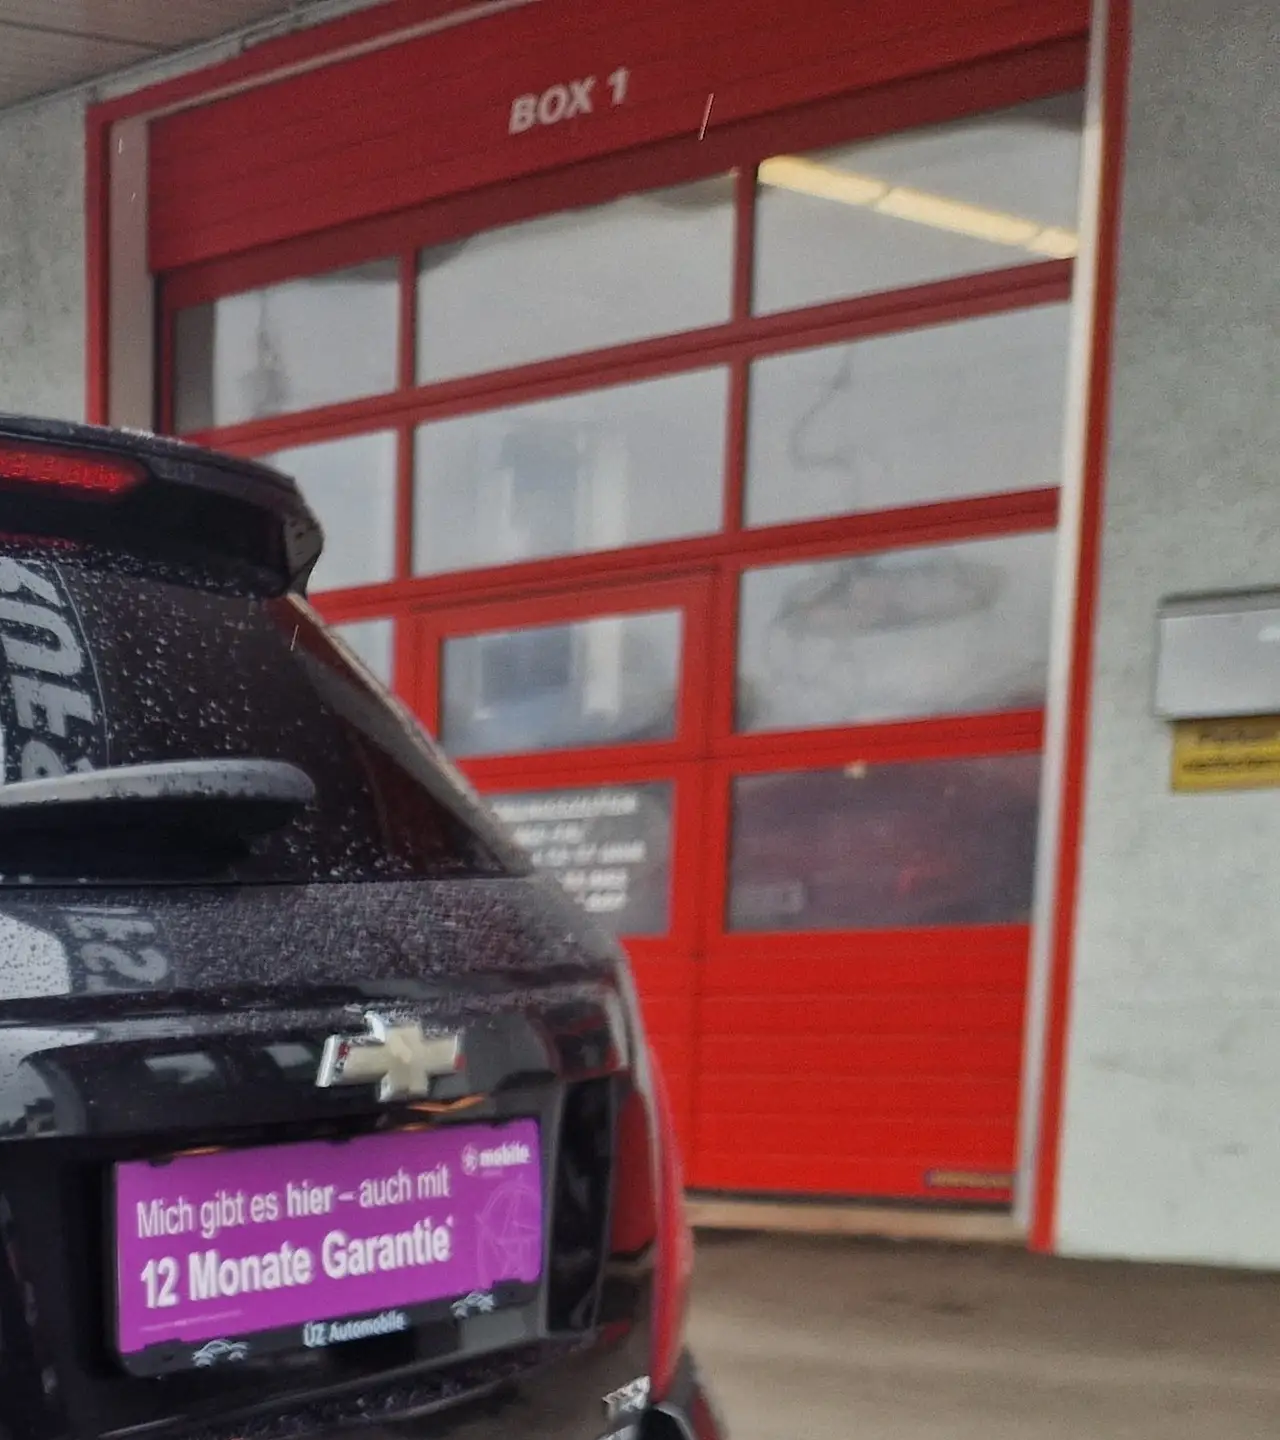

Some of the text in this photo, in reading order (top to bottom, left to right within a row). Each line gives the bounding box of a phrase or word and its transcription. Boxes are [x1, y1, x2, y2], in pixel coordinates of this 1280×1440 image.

[508, 67, 630, 135] BOX 1
[137, 1195, 194, 1239] Mich
[200, 1188, 245, 1239] gibt
[250, 1192, 279, 1222] es
[287, 1179, 335, 1217] hier
[359, 1166, 412, 1208] auch
[417, 1162, 452, 1200] mit
[141, 1256, 180, 1309] 12
[189, 1240, 313, 1301] Monate
